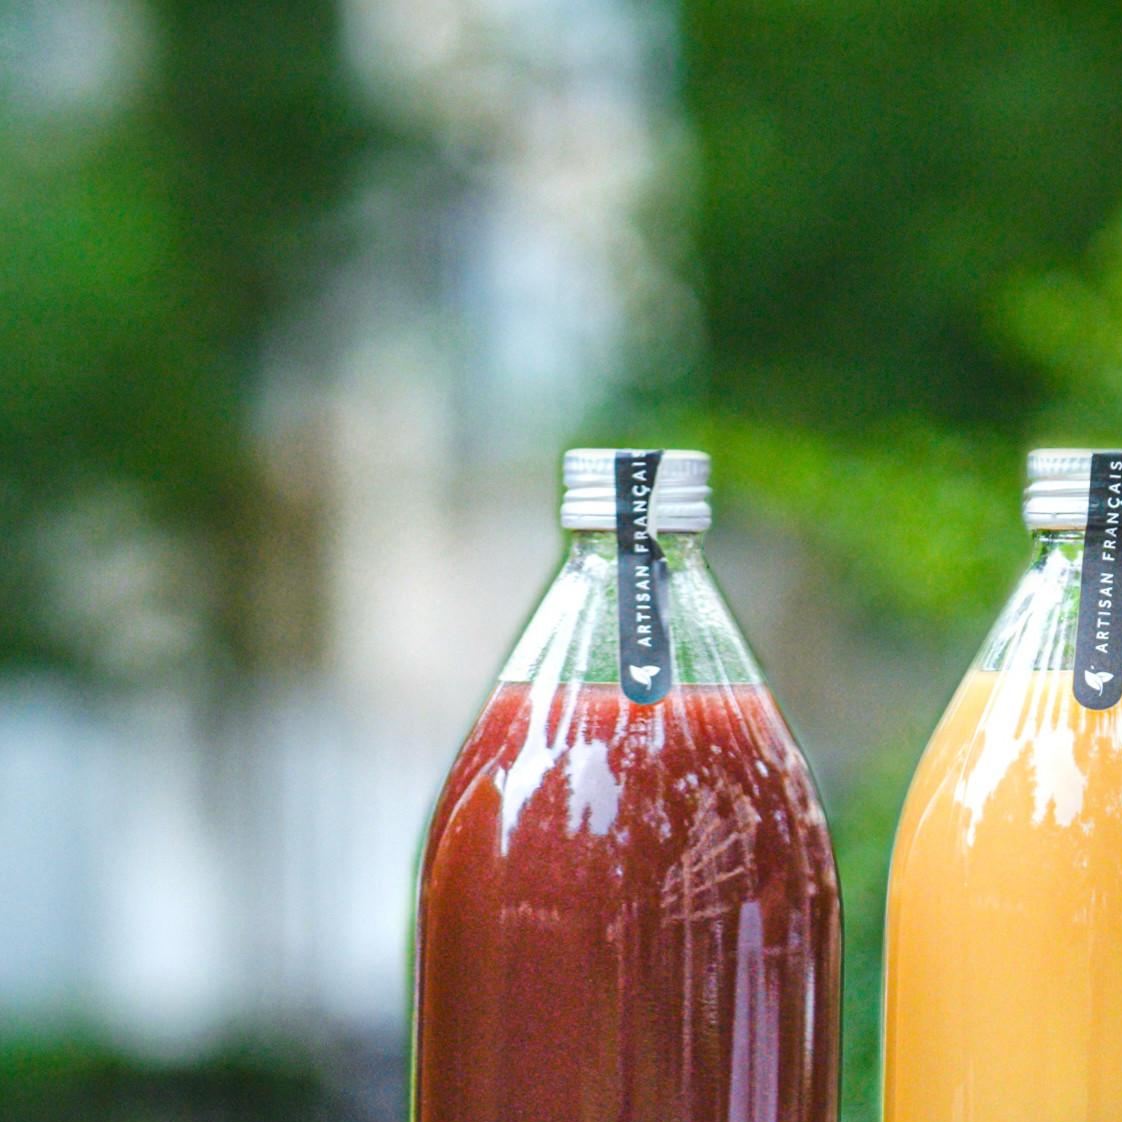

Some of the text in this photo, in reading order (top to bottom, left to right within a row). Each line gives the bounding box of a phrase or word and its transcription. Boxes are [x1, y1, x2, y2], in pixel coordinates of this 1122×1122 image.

[635, 565, 653, 648] ARTISAN
[1095, 461, 1122, 654] ARTISAN FRANÇAIS
